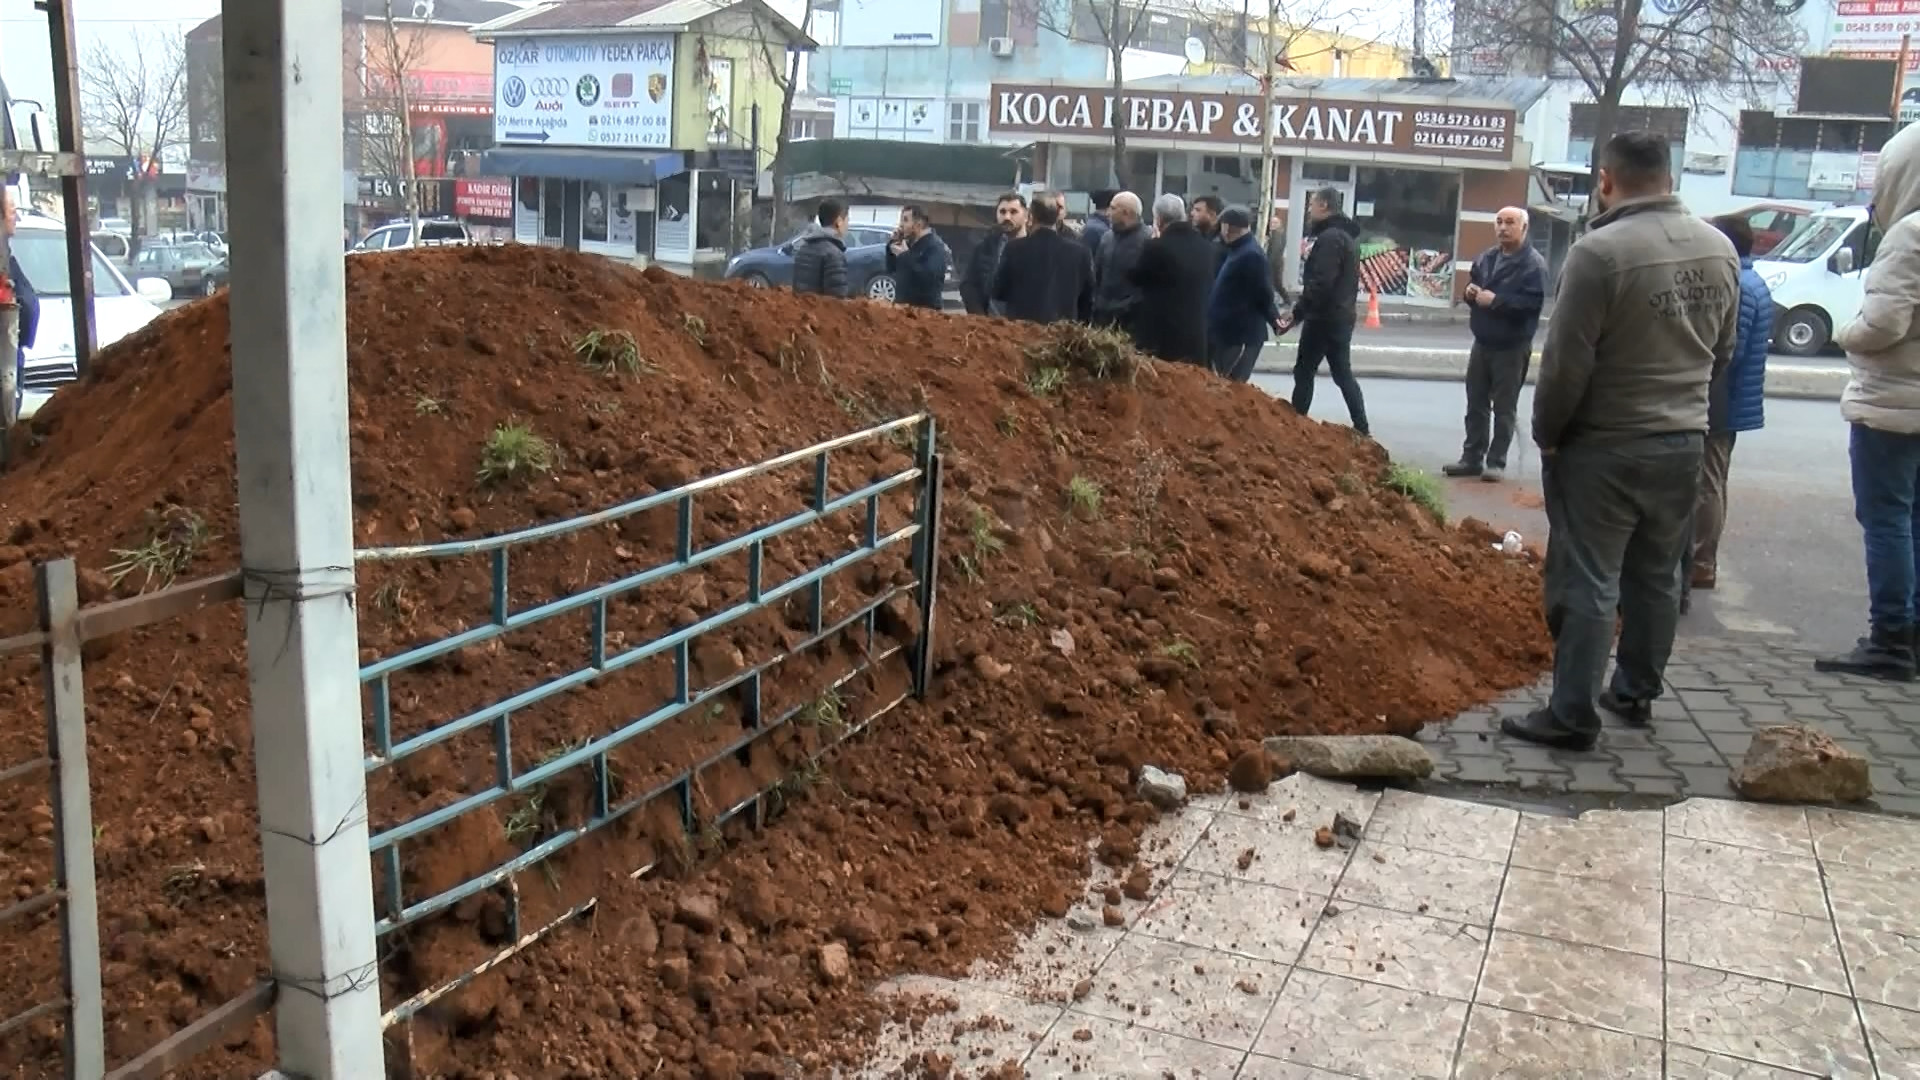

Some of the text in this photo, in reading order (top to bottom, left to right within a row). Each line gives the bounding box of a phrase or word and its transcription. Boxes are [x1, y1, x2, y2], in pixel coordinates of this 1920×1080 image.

[600, 43, 635, 62] YEDEK
[637, 42, 672, 65] PARÇA
[509, 115, 534, 127] Metre
[601, 116, 622, 126] 0216
[999, 92, 1093, 128] KOCA
[1232, 103, 1261, 137] &
[1270, 104, 1403, 146] KANAT
[1415, 111, 1507, 129] 0536 573 61 83
[601, 131, 621, 142] 0537
[624, 131, 640, 142] 211
[1414, 132, 1506, 149] 0216 487 60 42
[1674, 268, 1705, 284] CAN
